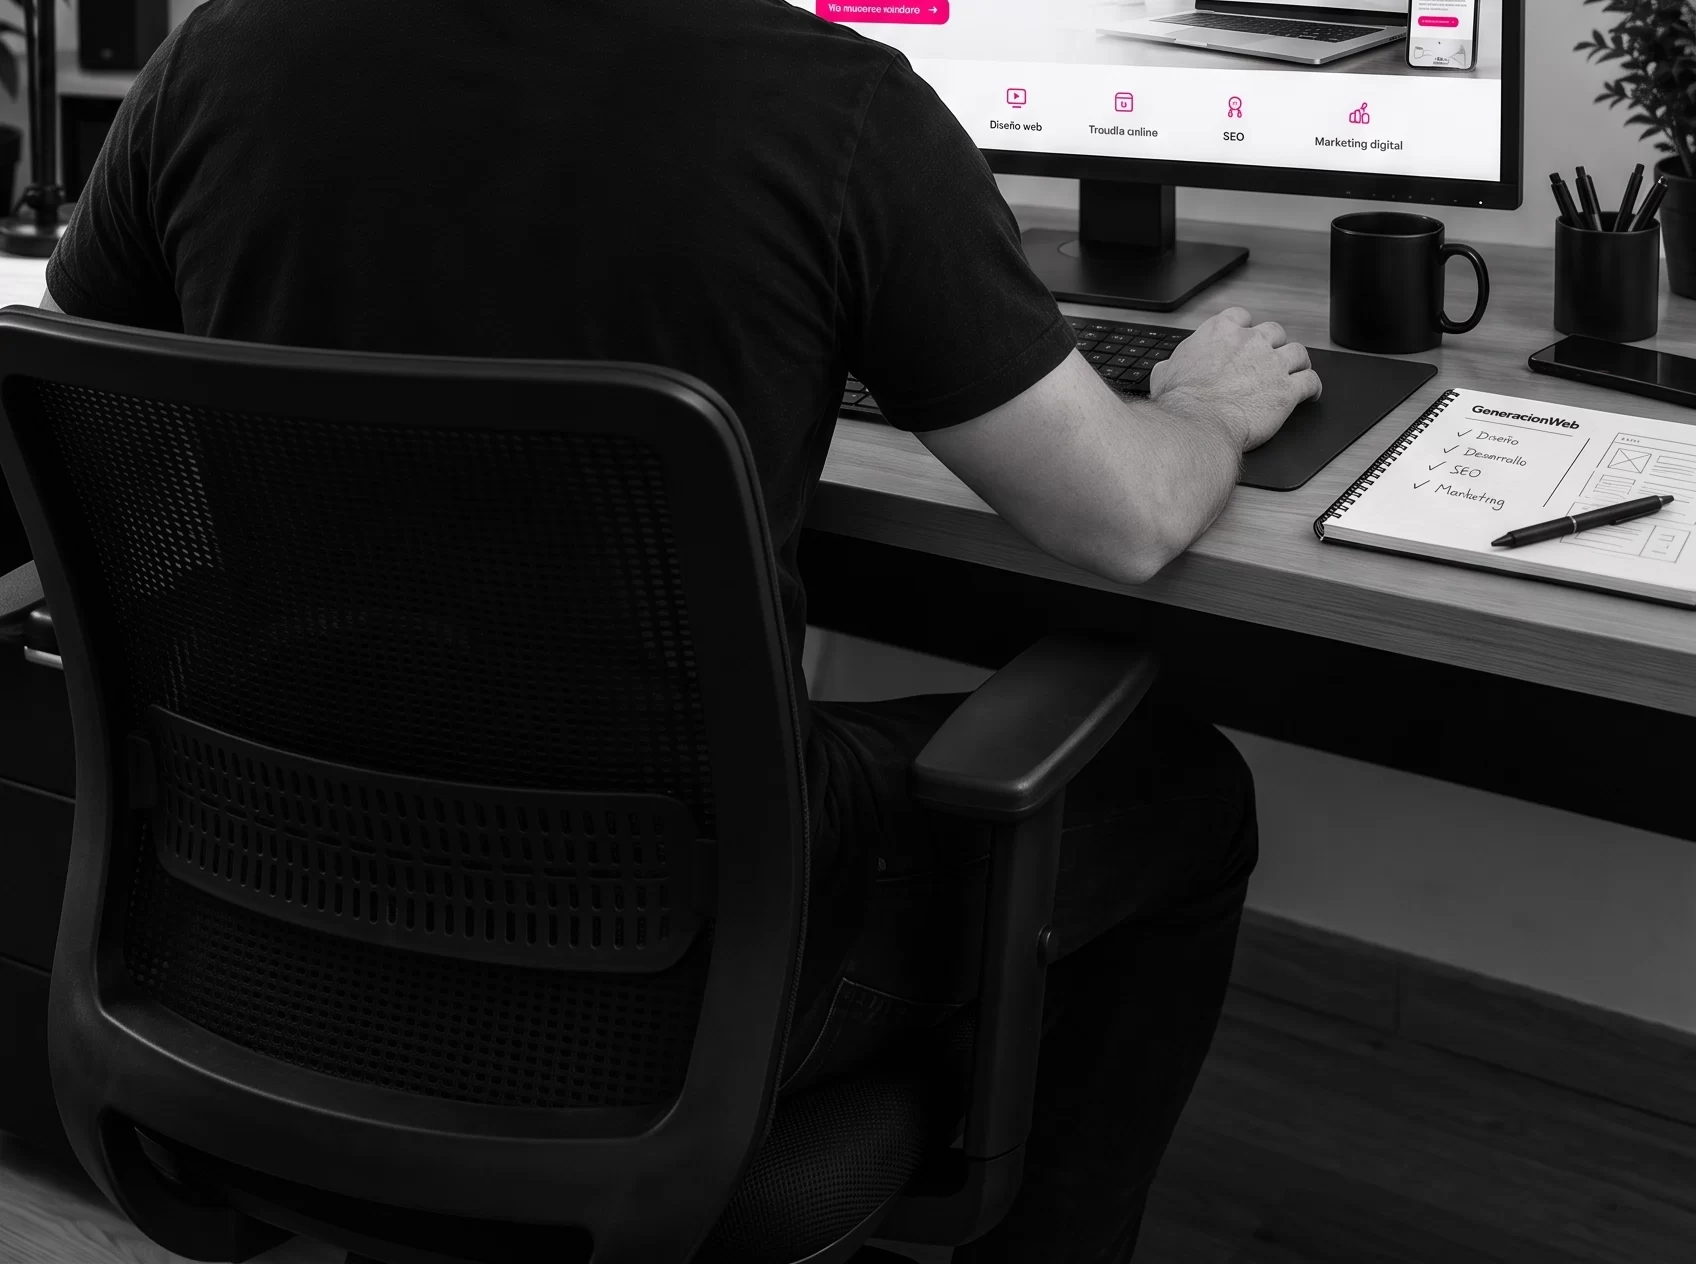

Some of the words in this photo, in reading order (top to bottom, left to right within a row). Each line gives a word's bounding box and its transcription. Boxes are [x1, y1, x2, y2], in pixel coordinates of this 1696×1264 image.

[989, 119, 1021, 132] Diseño
[1022, 121, 1043, 133] web
[1222, 131, 1245, 142] SEO
[1314, 136, 1368, 151] Marketing
[1369, 138, 1404, 152] digital
[1471, 404, 1581, 431] GeneracionWeb
[1449, 464, 1482, 478] SEO
